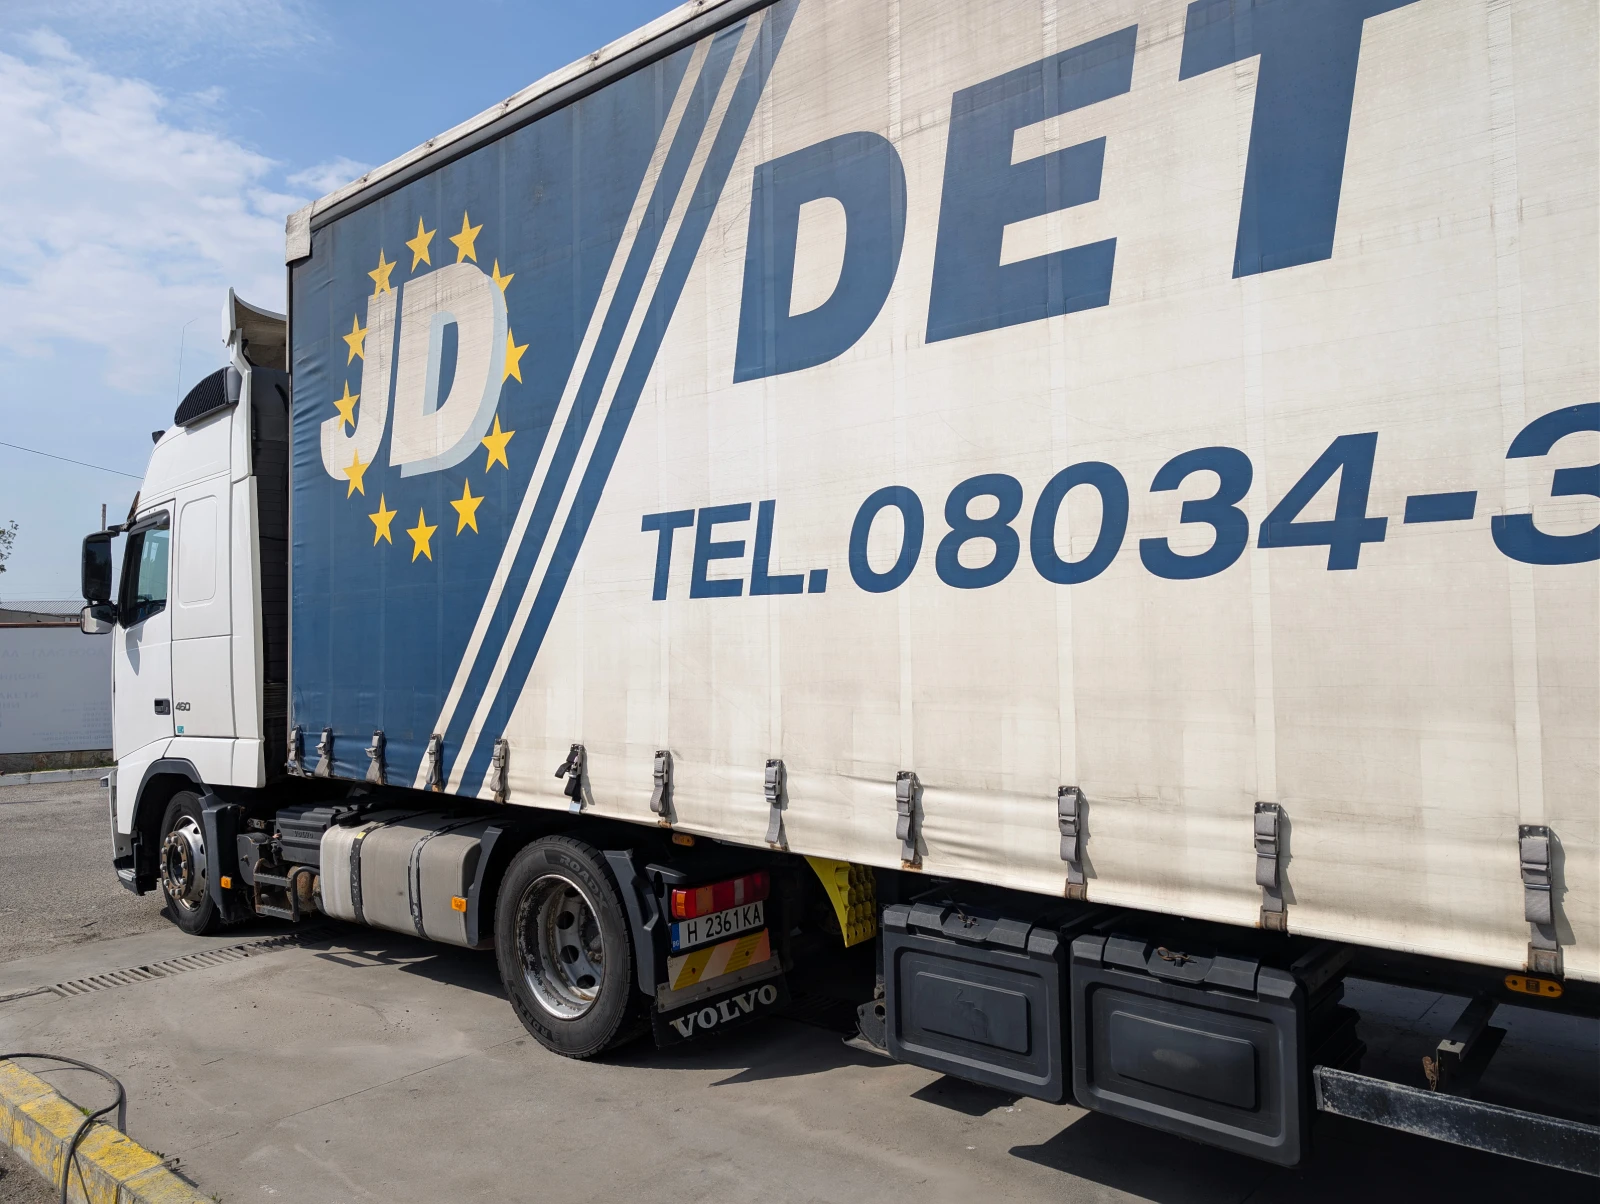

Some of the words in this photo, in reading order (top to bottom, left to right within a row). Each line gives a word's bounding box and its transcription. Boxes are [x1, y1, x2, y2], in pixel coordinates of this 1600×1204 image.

[733, 0, 1418, 384] DET
[320, 262, 508, 481] JD
[175, 701, 191, 711] 460
[559, 853, 609, 910] ROADX
[668, 984, 778, 1038] VOLVO
